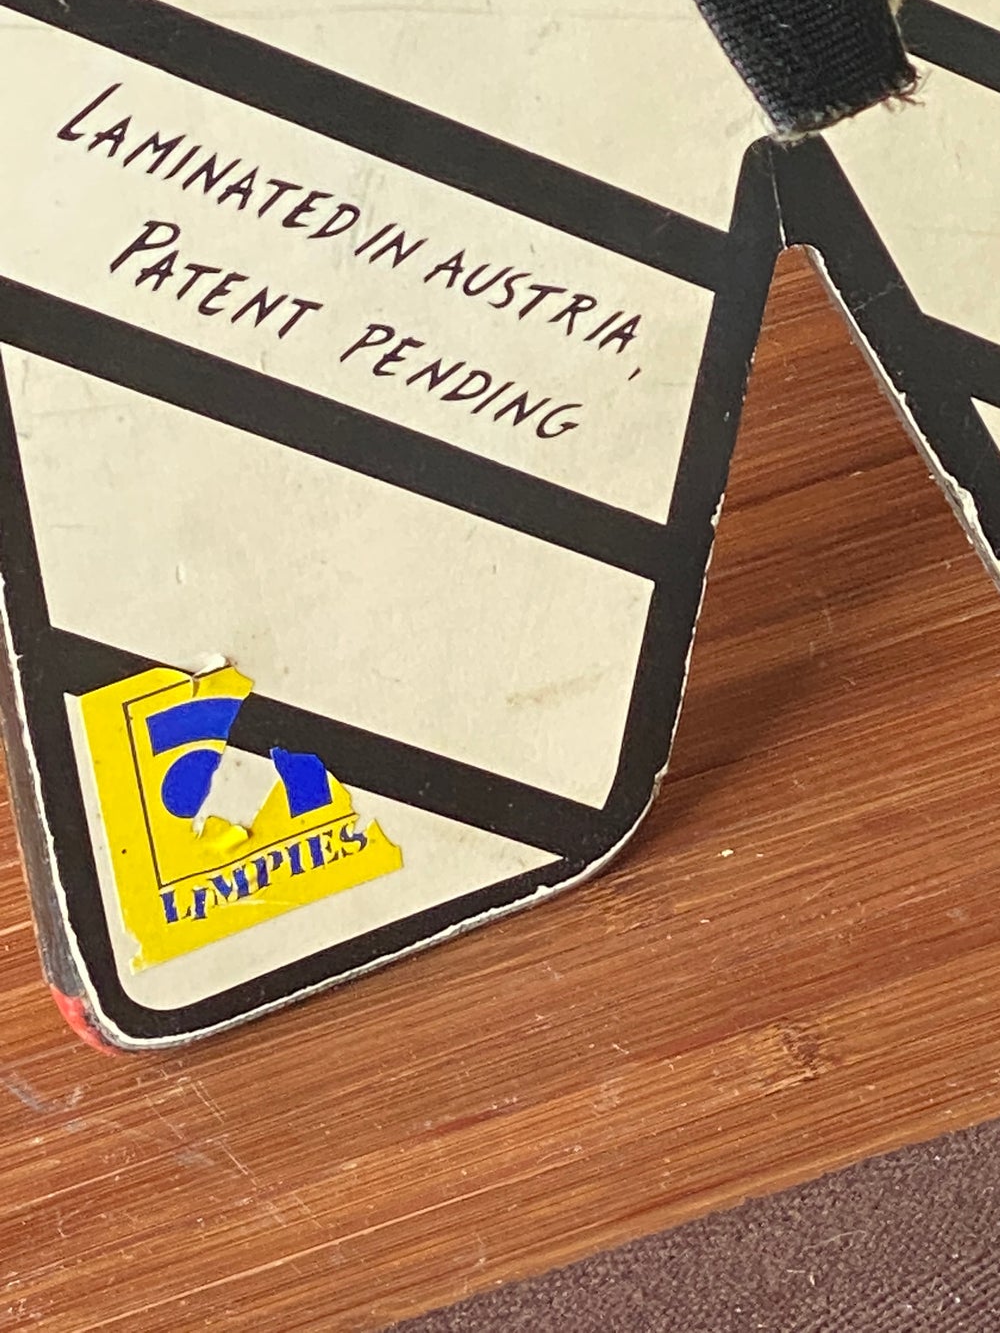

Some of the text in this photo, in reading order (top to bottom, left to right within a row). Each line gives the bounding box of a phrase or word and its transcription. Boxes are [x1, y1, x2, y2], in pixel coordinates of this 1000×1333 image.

[57, 82, 643, 381] LAMINATED IN AUSTRIA,
[109, 220, 584, 440] PATENT PENDING
